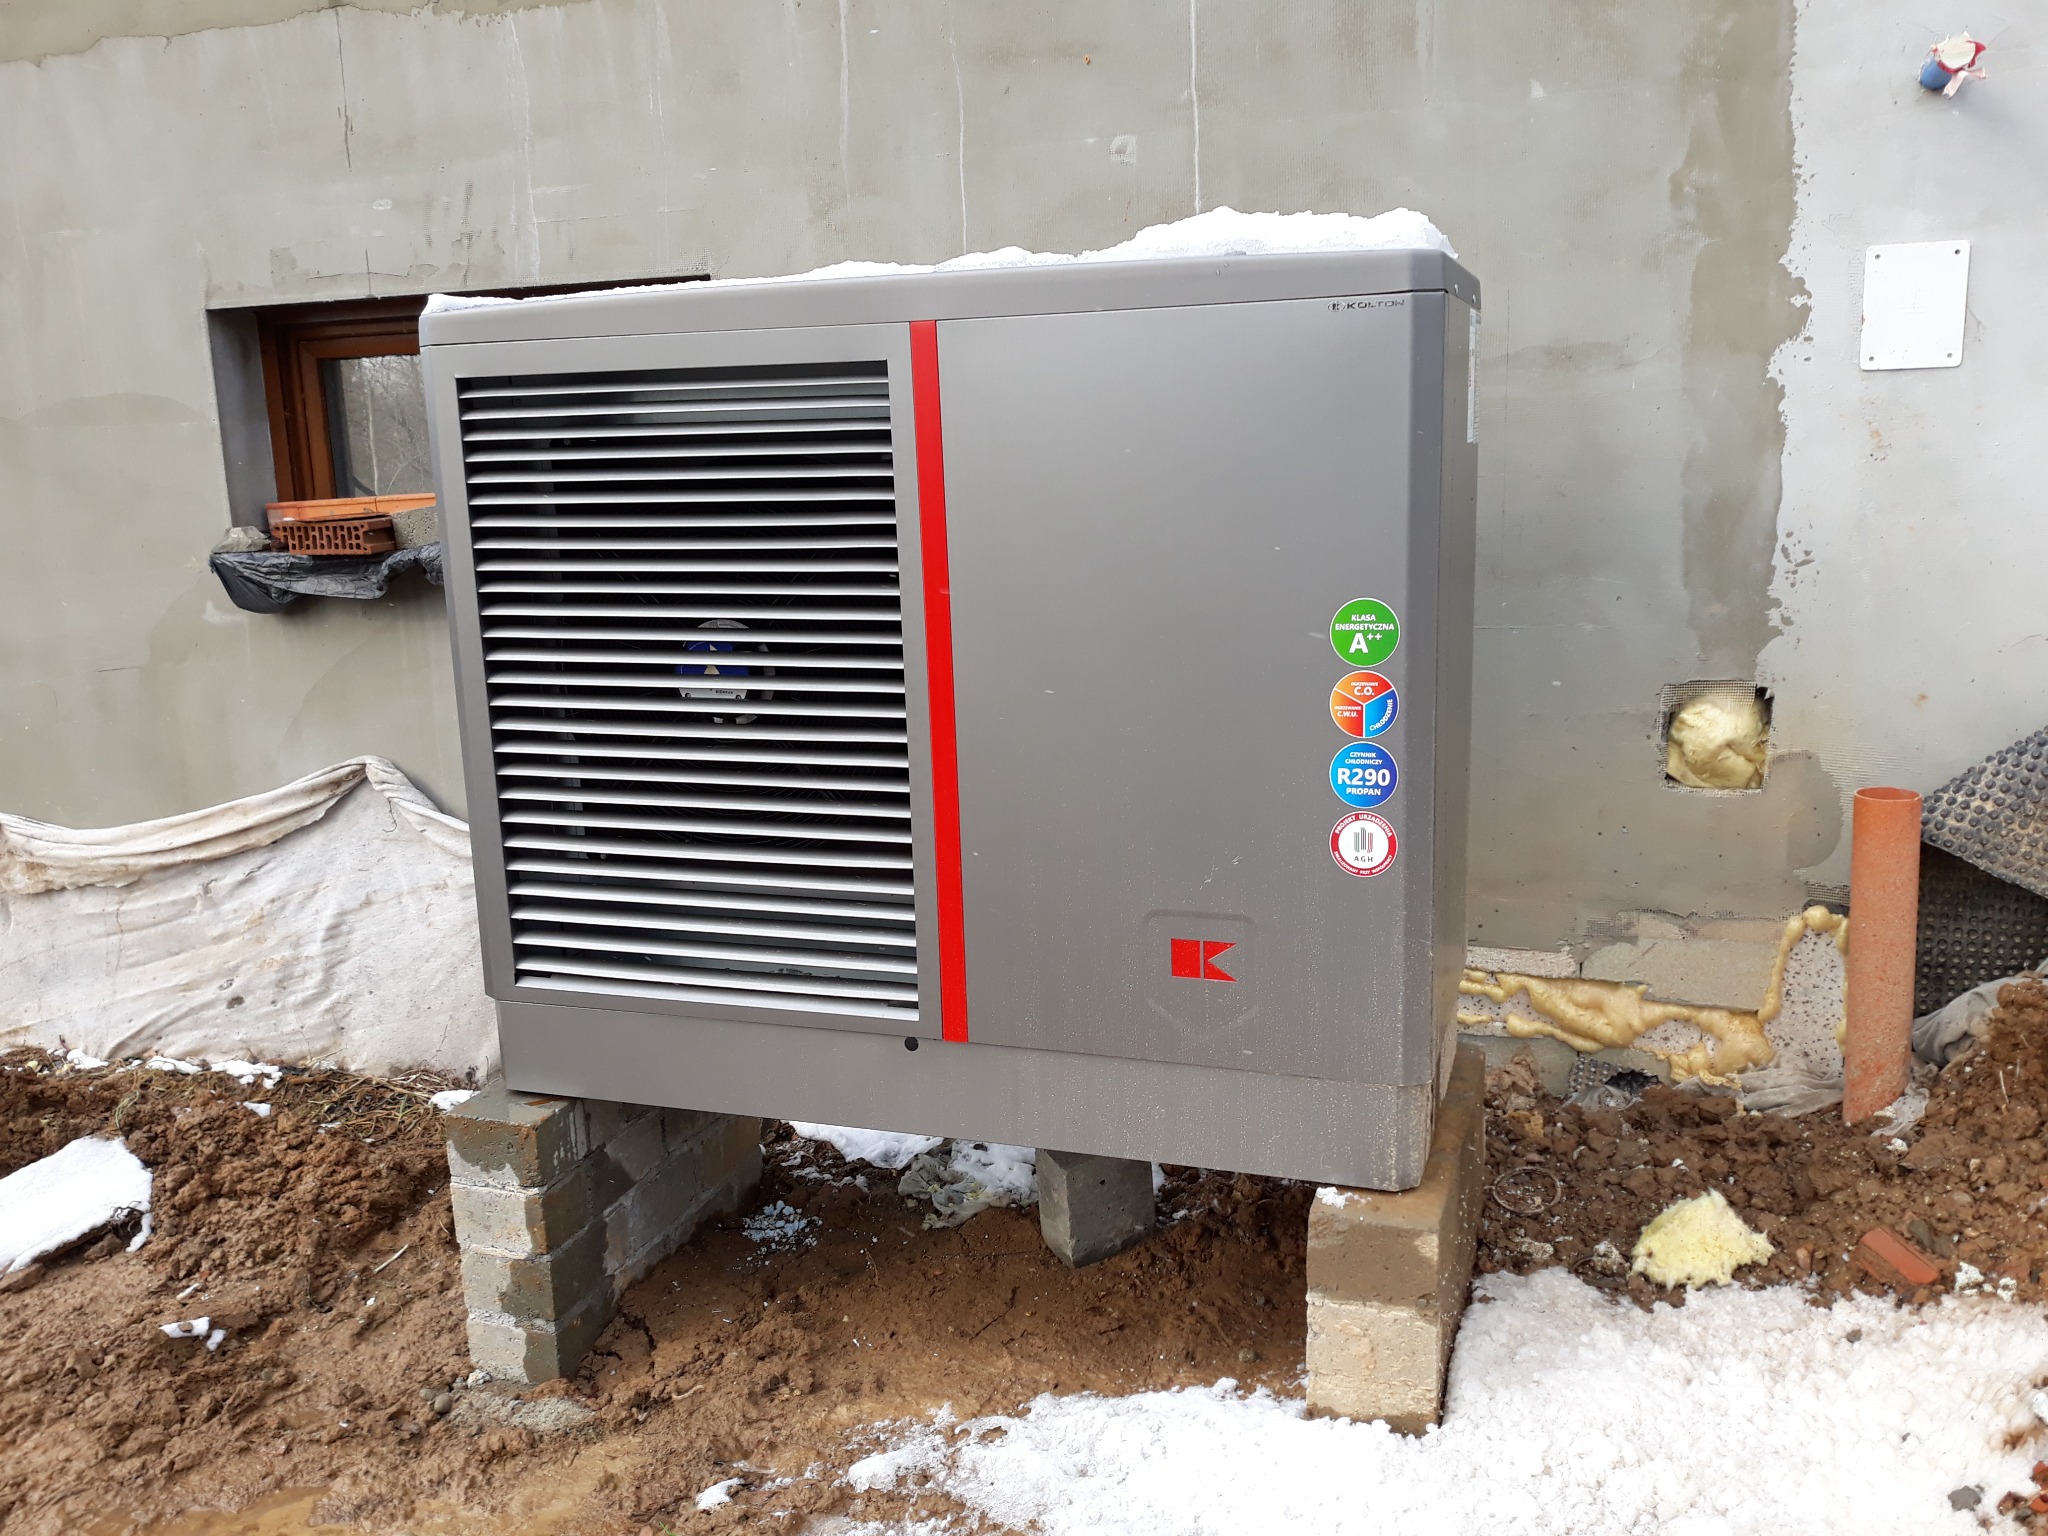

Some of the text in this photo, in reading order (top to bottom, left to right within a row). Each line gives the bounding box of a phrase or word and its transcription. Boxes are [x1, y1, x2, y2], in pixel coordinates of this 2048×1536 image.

[1347, 299, 1405, 310] KOLTON
[1353, 686, 1374, 695] C.O.
[1337, 768, 1390, 786] R290
[1335, 814, 1393, 837] PROJEKT URZĄDZENIA
